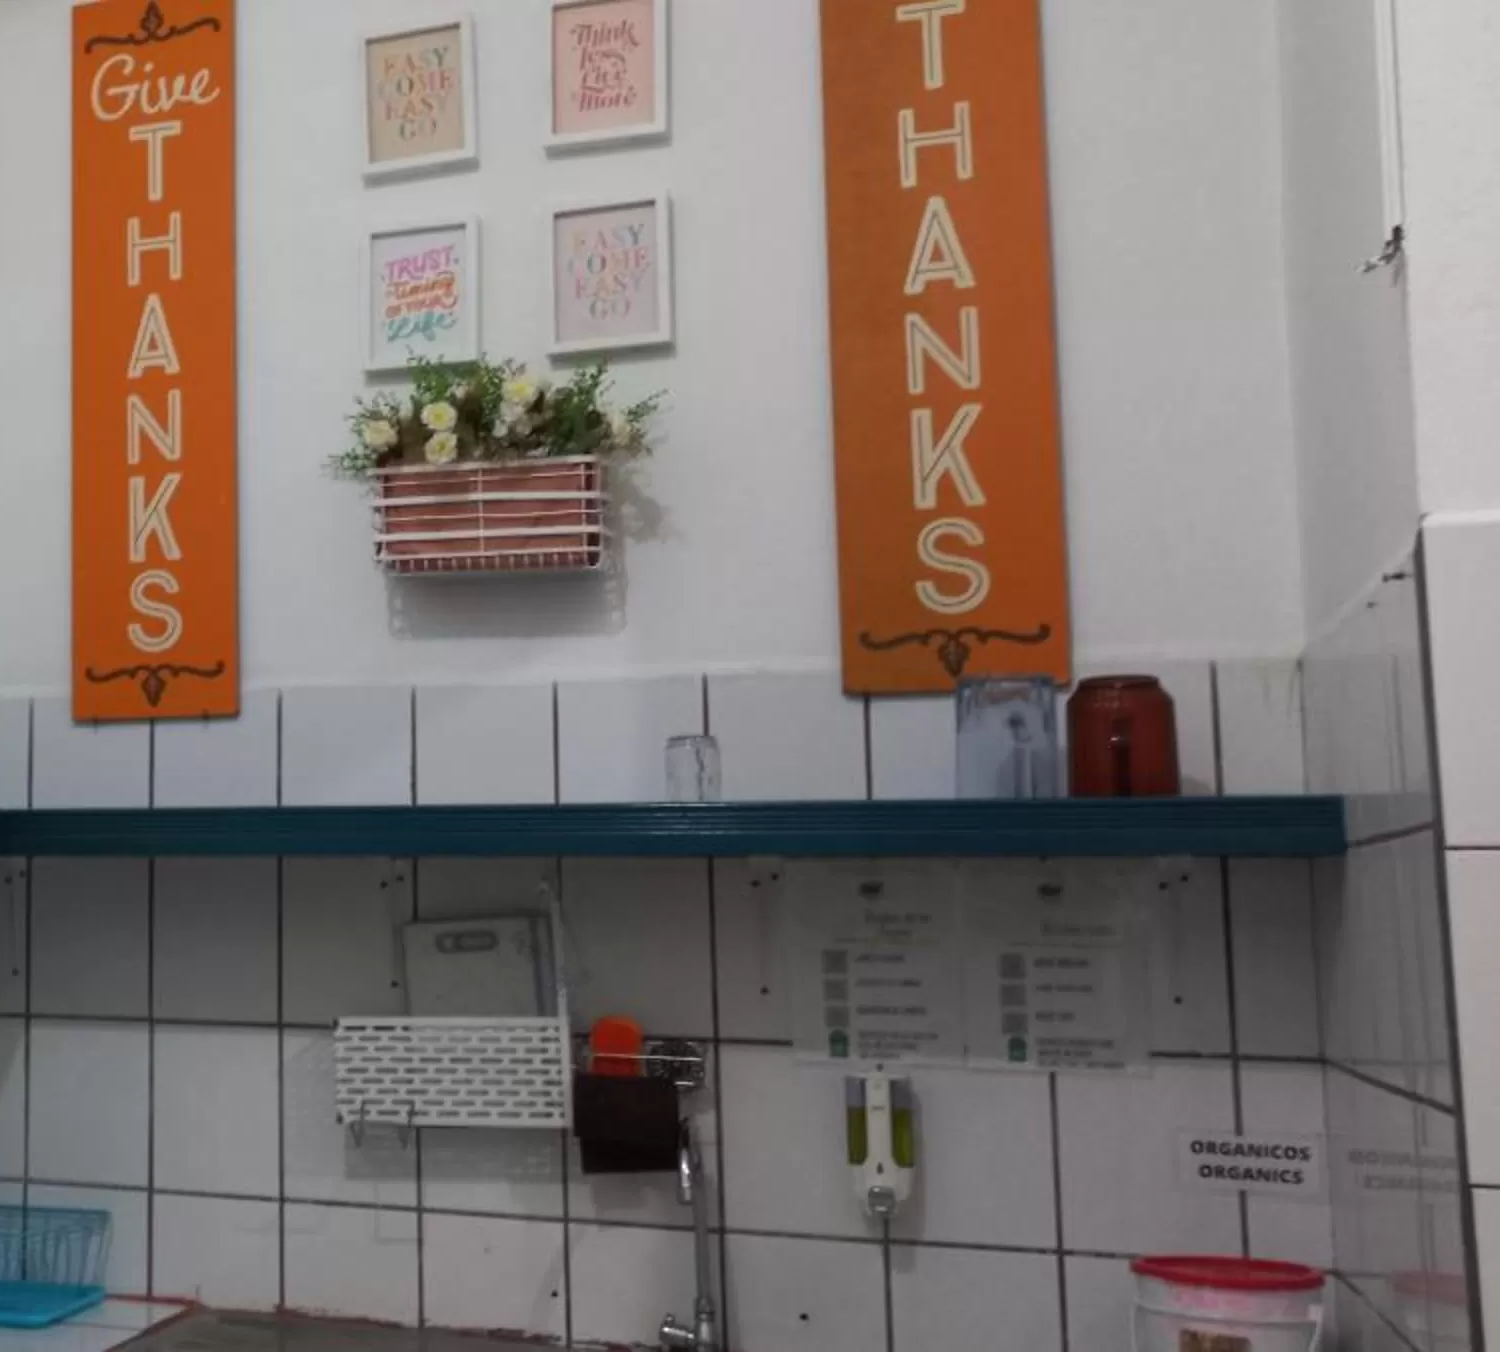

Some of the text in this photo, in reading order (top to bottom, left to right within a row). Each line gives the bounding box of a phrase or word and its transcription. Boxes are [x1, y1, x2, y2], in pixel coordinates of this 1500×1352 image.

[90, 53, 220, 121] Give
[399, 117, 437, 141] GO
[589, 298, 632, 320] GO
[895, 0, 991, 615] THANKS
[127, 120, 184, 654] THANKS
[1190, 1139, 1311, 1162] ORGANICOS
[1197, 1163, 1305, 1186] ORGANICS
